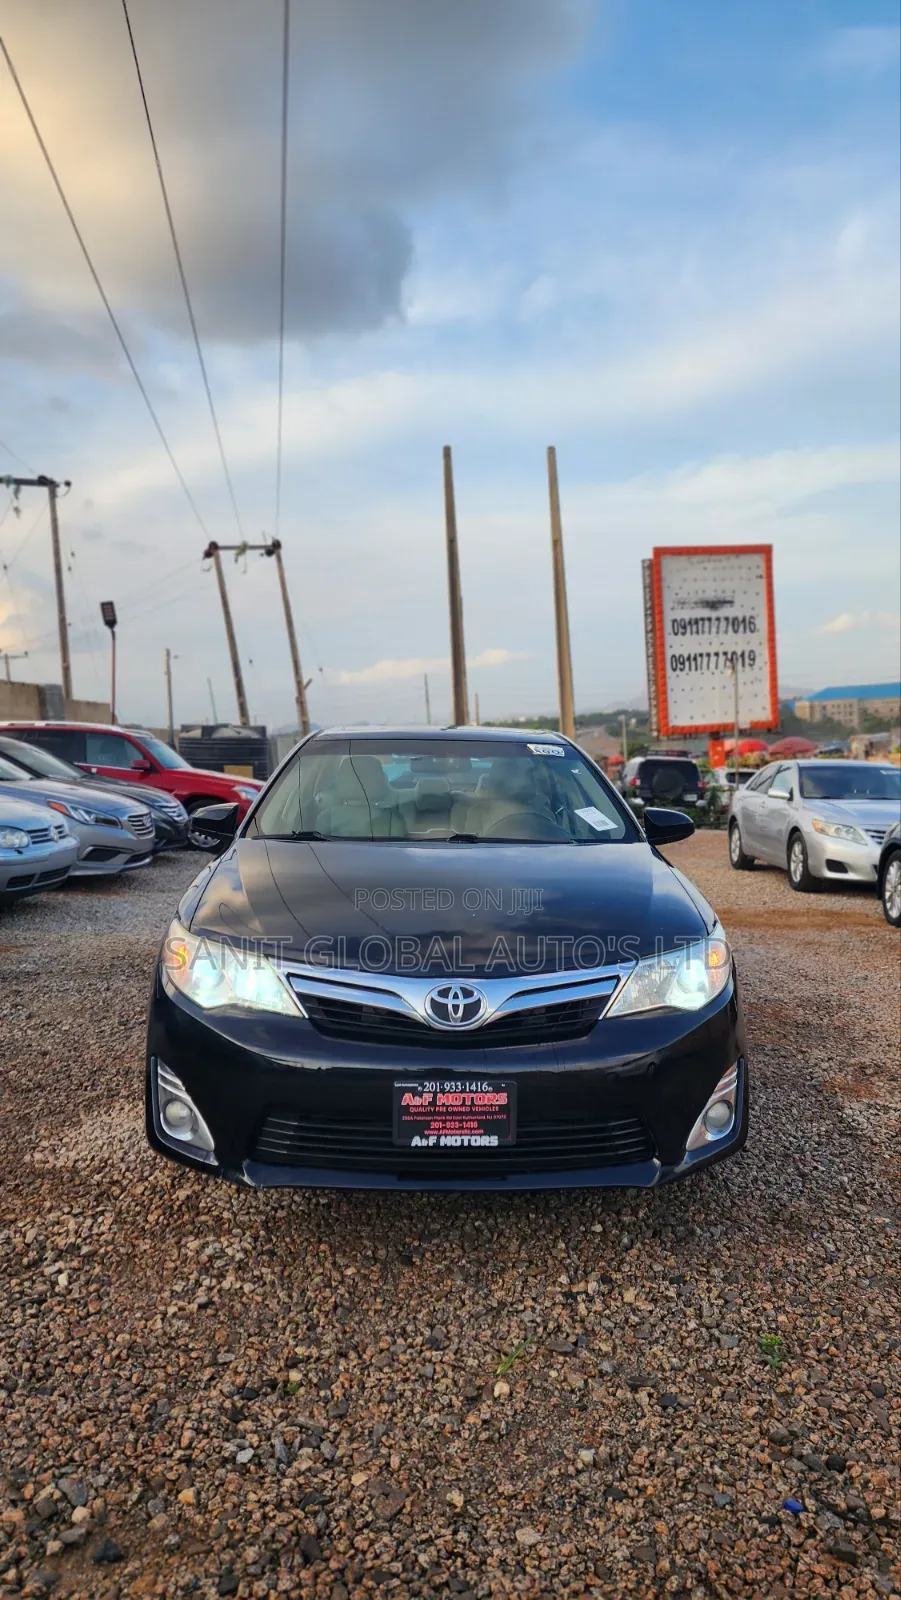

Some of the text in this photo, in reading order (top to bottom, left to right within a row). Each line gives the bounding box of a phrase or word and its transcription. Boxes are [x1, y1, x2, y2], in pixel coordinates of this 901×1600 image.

[671, 615, 757, 636] 09117777016
[669, 649, 756, 672] 09117777019
[401, 1092, 508, 1106] A&F MOTORS
[411, 1135, 499, 1147] A&F MOTORS
